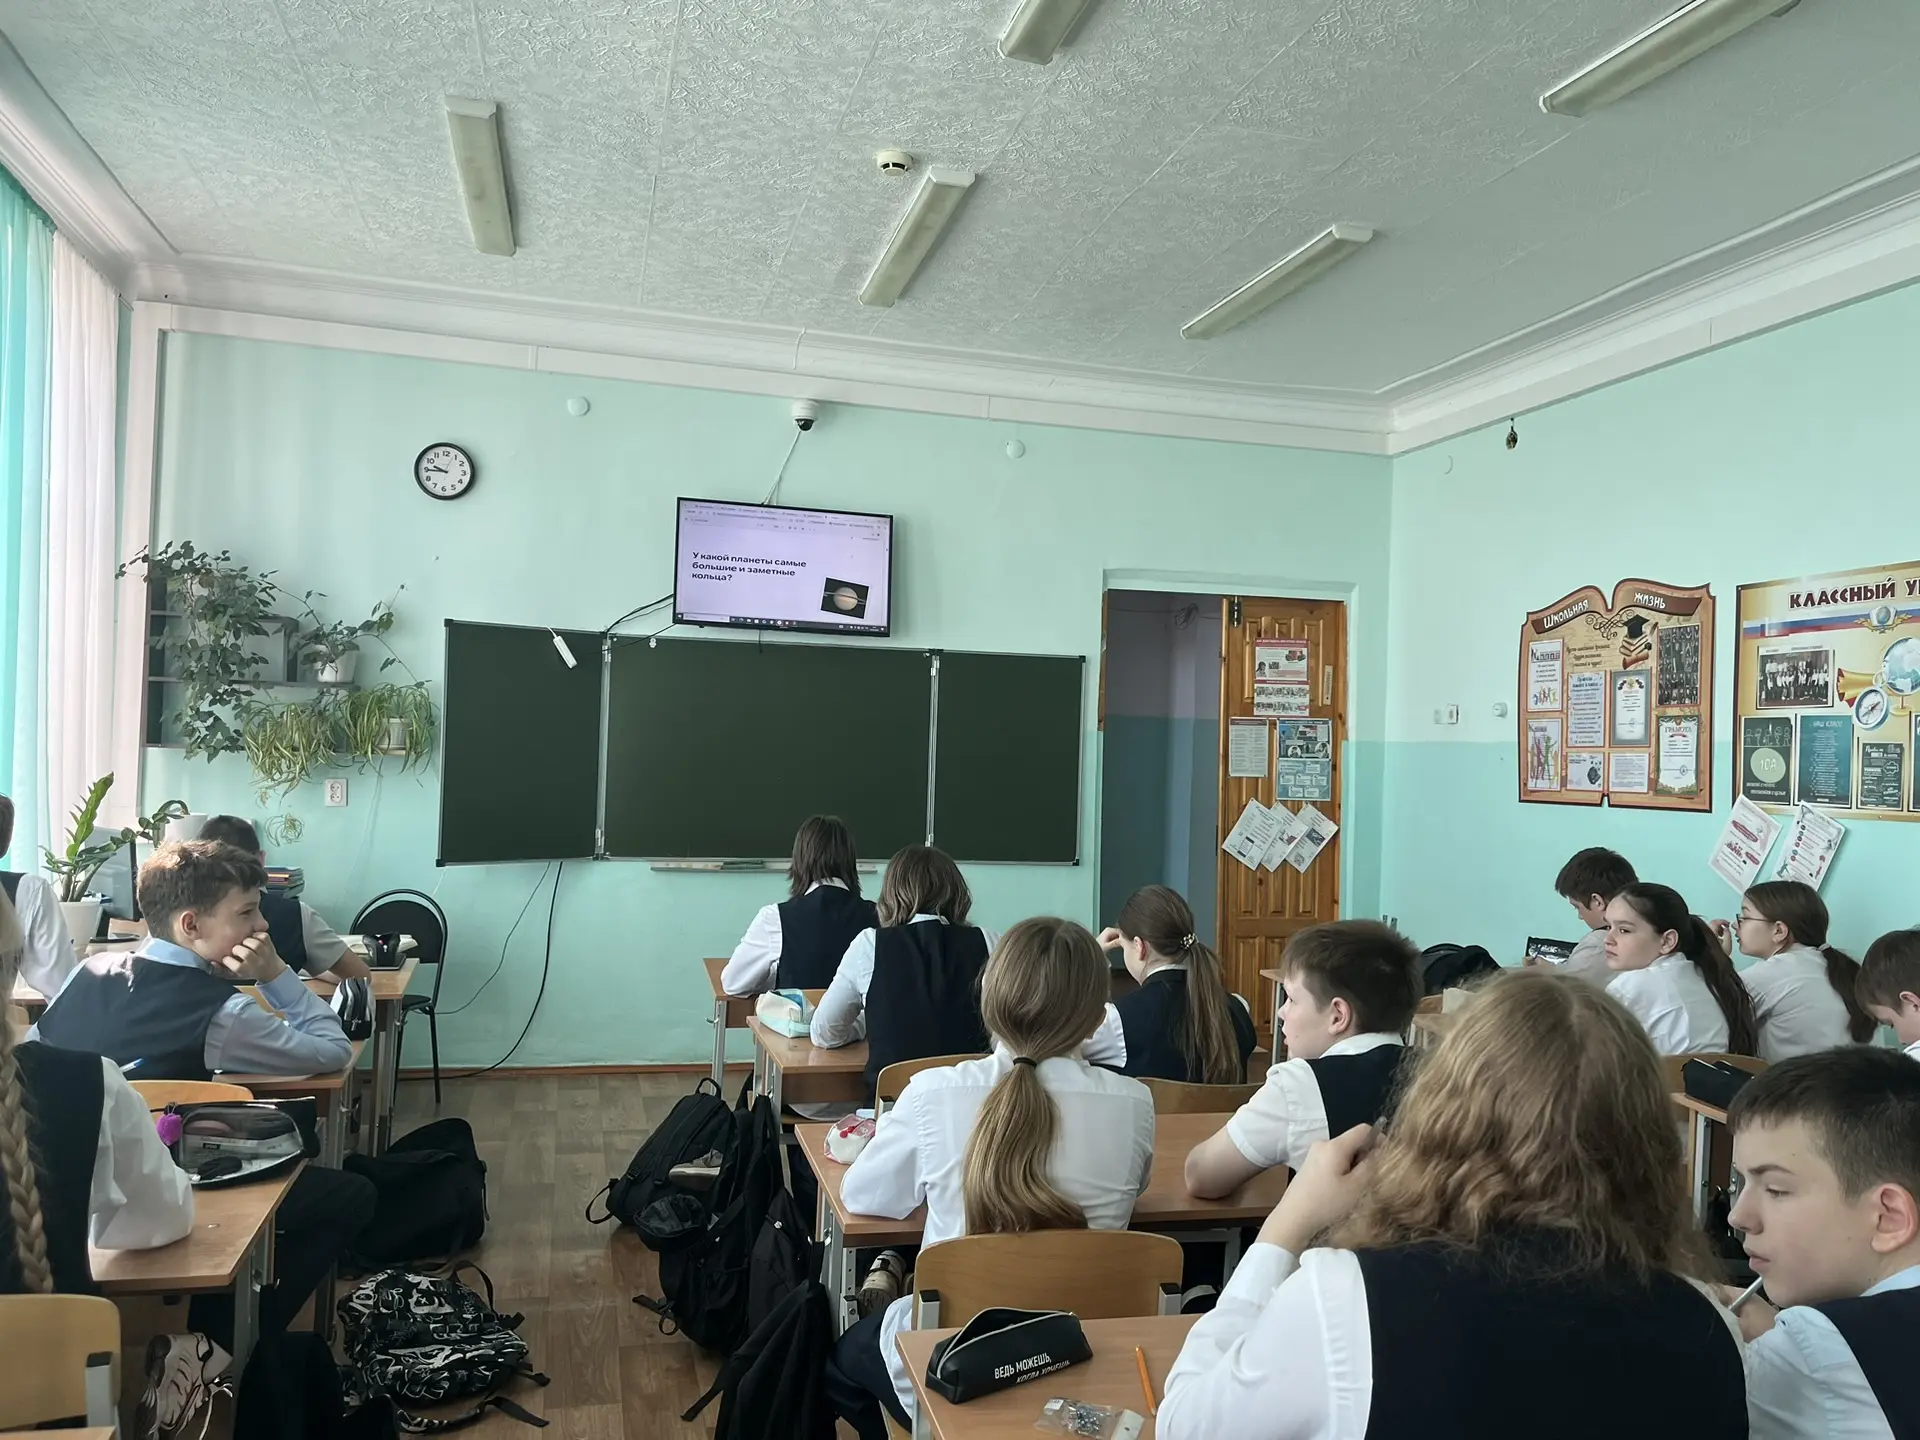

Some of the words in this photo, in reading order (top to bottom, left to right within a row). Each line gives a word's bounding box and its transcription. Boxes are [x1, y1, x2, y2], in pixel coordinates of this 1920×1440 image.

[700, 553, 729, 561] какой
[731, 556, 773, 565] планеты
[775, 559, 806, 567] самые
[692, 562, 737, 572] большие
[747, 567, 795, 576] заметные
[692, 573, 733, 581] кольца?
[1633, 592, 1666, 609] ЖИЗНЬ
[1789, 577, 1896, 609] КЛАССНЫЙ
[1905, 578, 1920, 596] У
[1543, 599, 1589, 628] ШКОЛЬНАЯ
[994, 1364, 1015, 1380] ВЕДЬ
[1015, 1352, 1052, 1373] МОЖЕШЬ,
